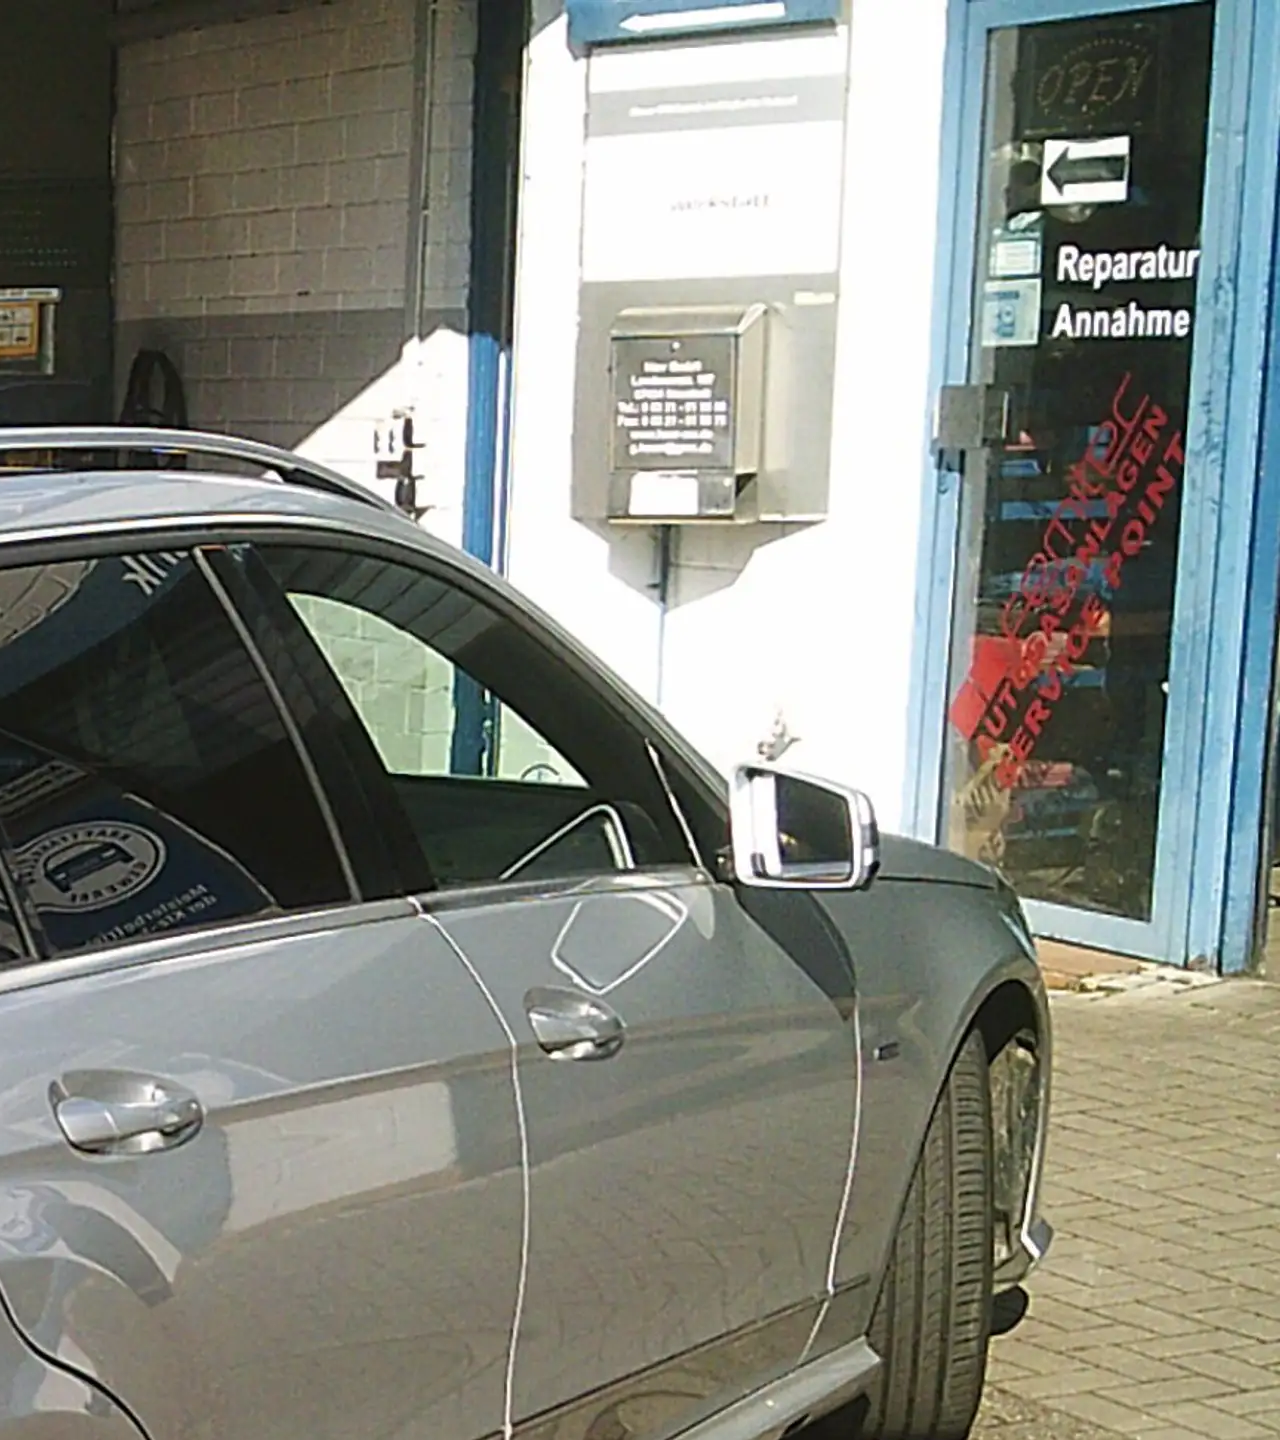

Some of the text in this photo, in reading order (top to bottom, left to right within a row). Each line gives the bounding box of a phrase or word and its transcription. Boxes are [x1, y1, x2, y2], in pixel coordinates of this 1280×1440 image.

[1038, 57, 1152, 105] OPEN
[1057, 244, 1202, 290] Reparatur
[1051, 301, 1190, 339] Annahme
[994, 430, 1187, 789] SERVICE POINT
